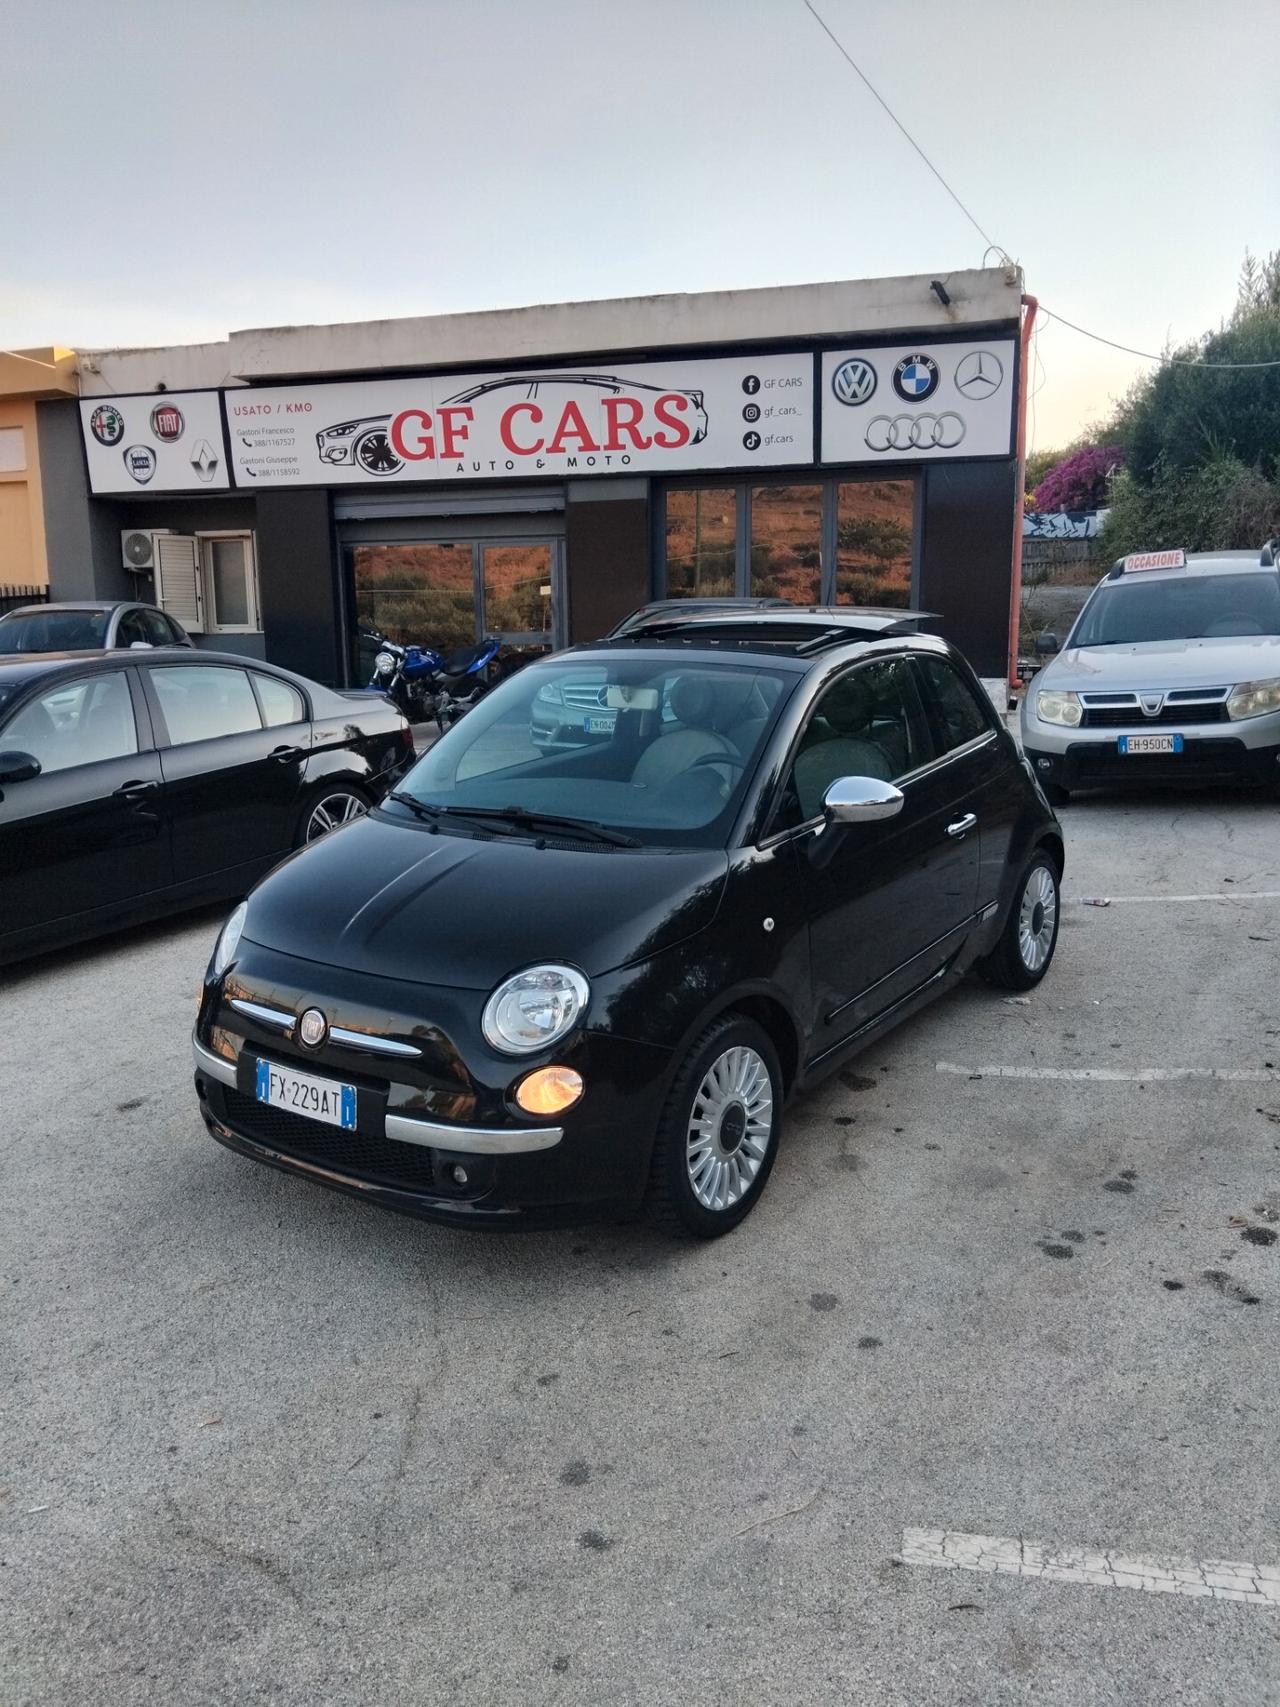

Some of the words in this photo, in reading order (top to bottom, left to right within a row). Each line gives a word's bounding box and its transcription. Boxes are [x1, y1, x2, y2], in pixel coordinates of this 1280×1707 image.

[898, 355, 936, 371] BMW
[764, 379, 776, 389] GF
[778, 377, 803, 388] CARS
[234, 404, 272, 416] USATO
[158, 413, 177, 432] FIAT
[391, 406, 474, 461] GF
[500, 394, 691, 456] CARS
[236, 427, 261, 436] Gastoni
[261, 427, 295, 435] Francesco
[240, 457, 265, 465] Gastoni
[266, 456, 298, 465] Giuseppe
[456, 460, 514, 472] AUTO
[536, 459, 545, 469] &
[567, 455, 631, 467] MOTO
[1127, 552, 1181, 569] OCCASIONE
